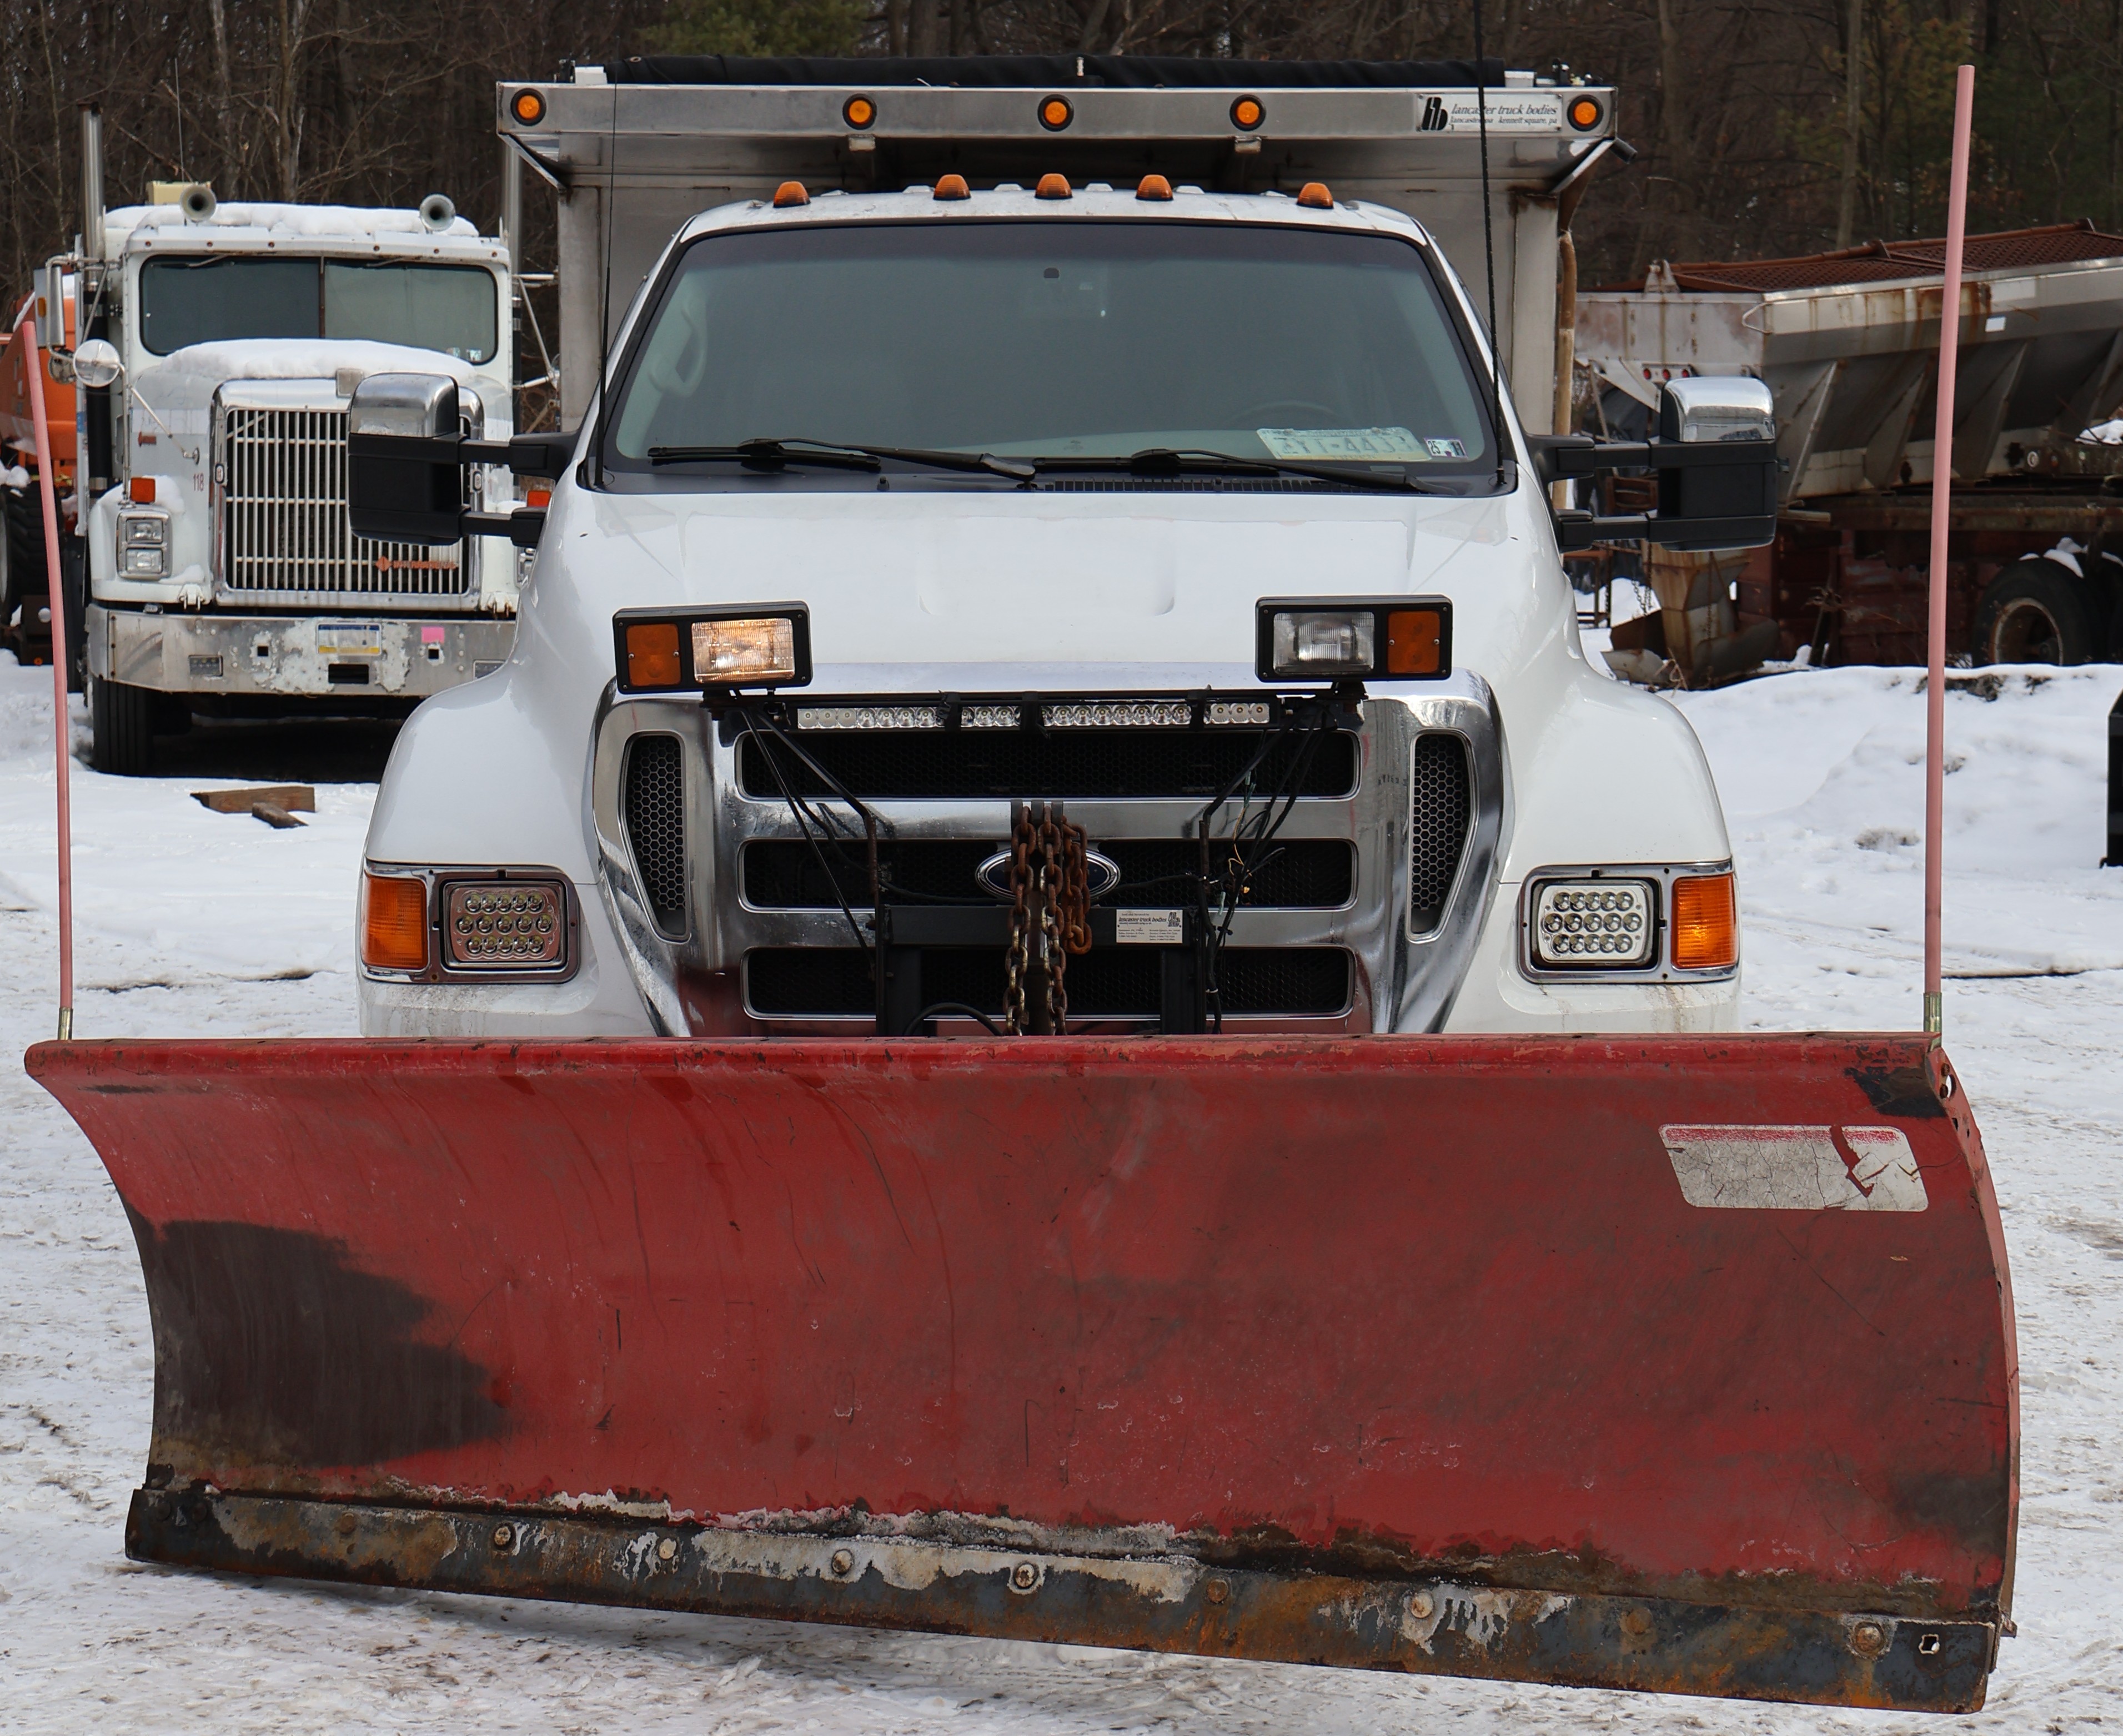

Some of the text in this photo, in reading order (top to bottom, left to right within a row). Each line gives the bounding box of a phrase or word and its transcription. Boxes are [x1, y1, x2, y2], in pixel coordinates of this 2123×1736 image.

[1451, 104, 1558, 114] lancaer truck bodies
[1428, 440, 1441, 454] 25
[193, 472, 204, 491] 118
